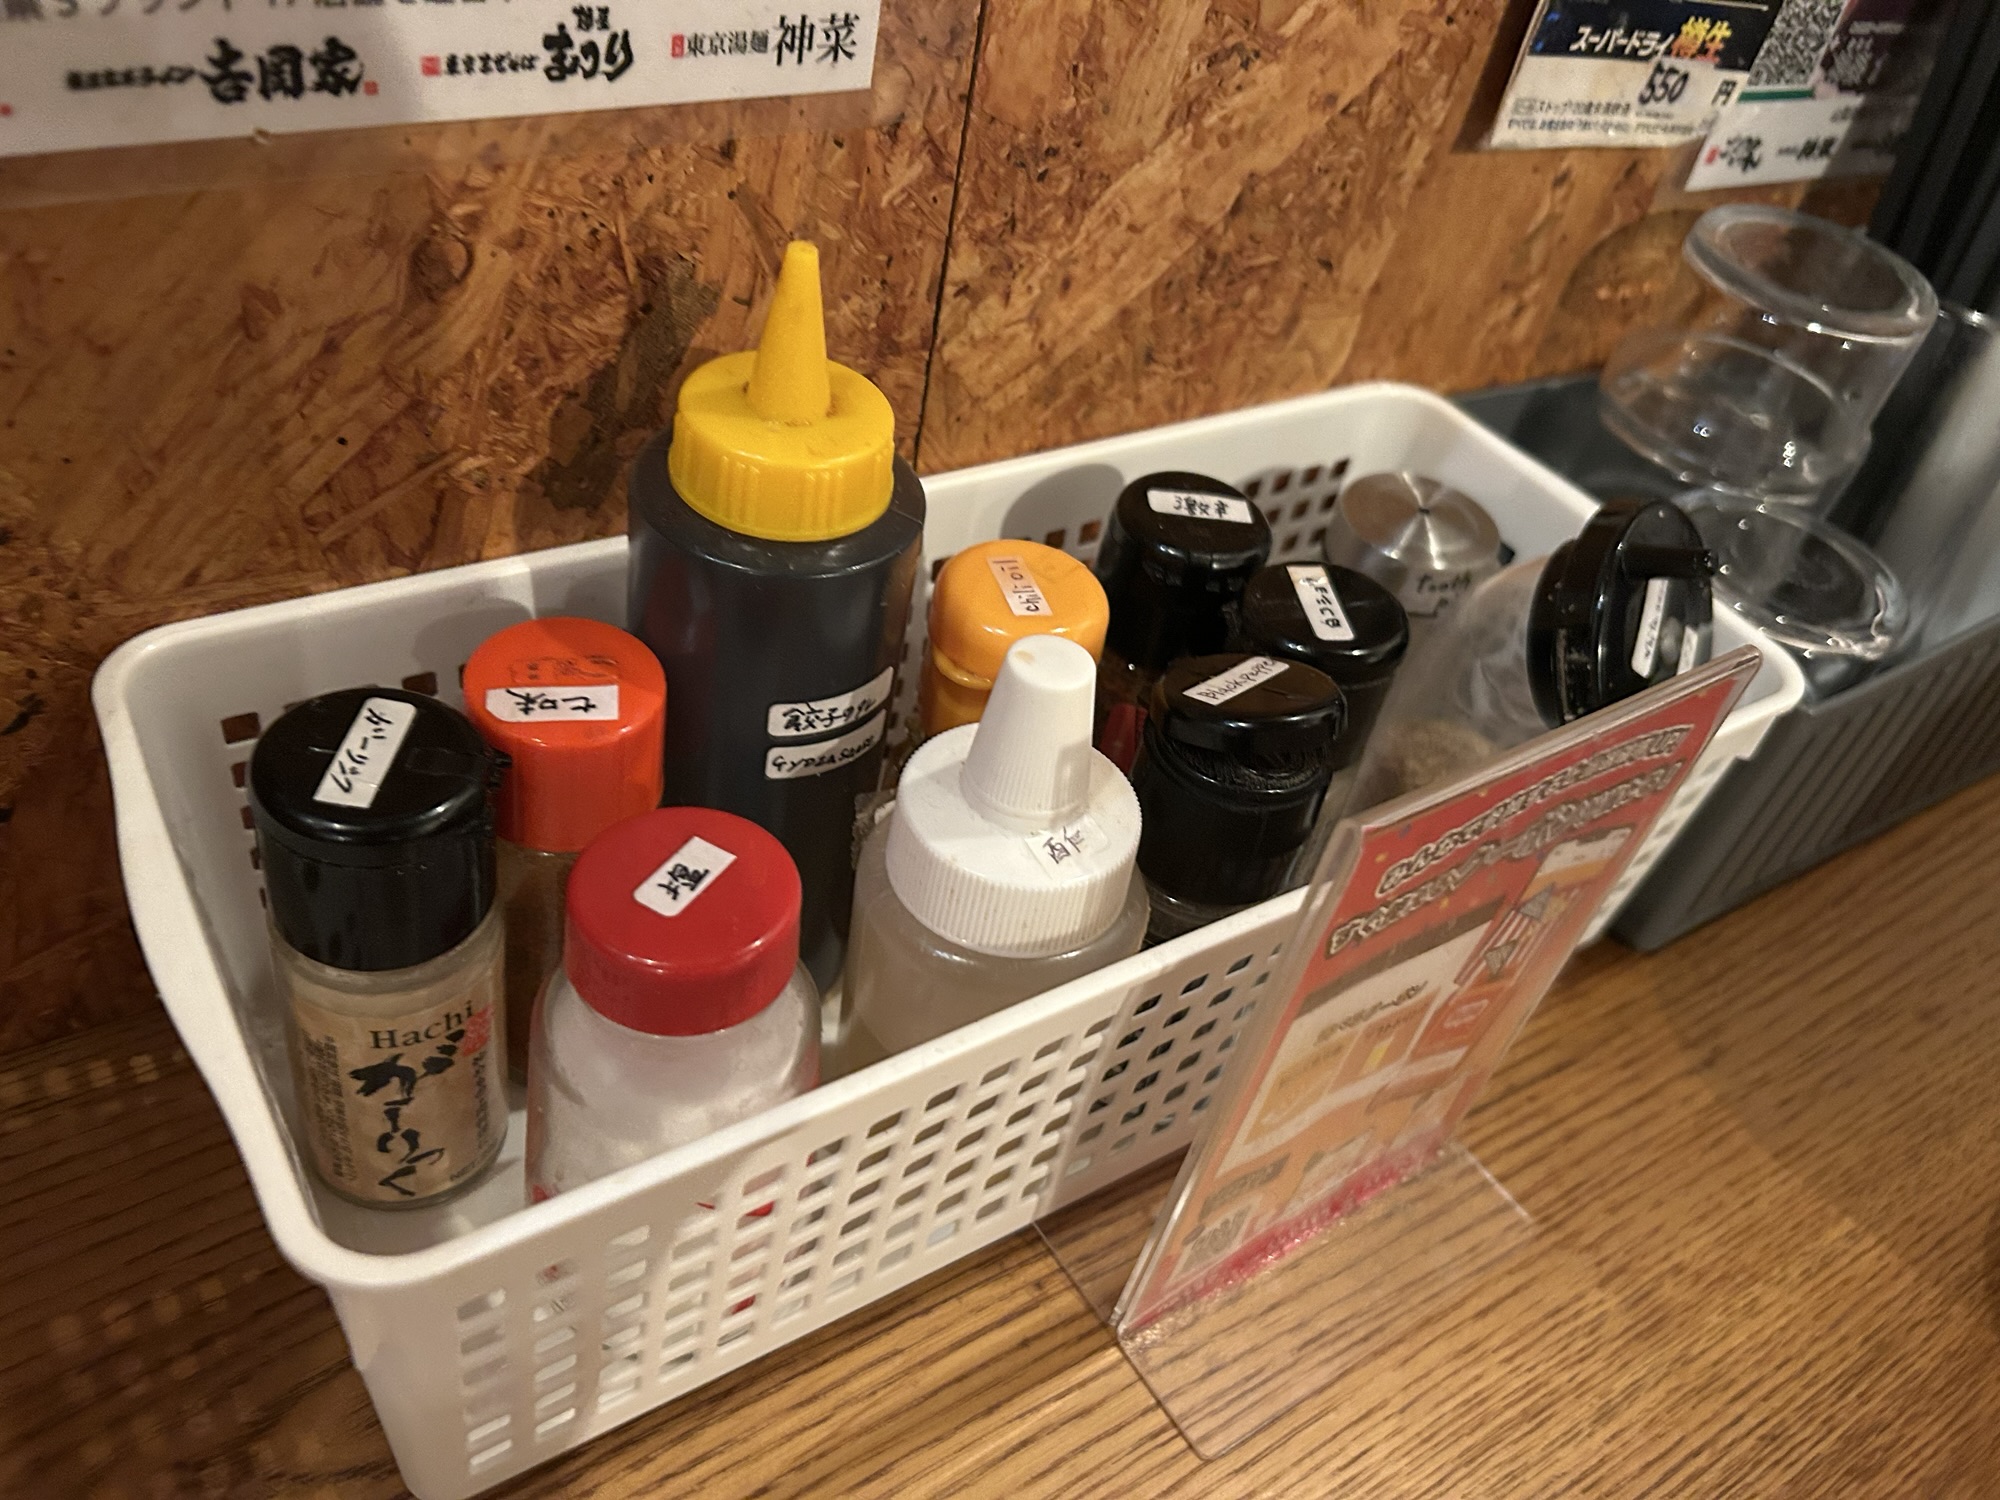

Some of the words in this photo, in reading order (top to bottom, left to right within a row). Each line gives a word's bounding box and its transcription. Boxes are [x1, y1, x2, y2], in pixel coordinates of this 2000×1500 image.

[773, 13, 860, 66] 神菜
[1638, 60, 1690, 105] 550
[506, 688, 597, 715] 七味
[331, 707, 394, 793] ガーリック
[368, 1000, 472, 1049] Hachi
